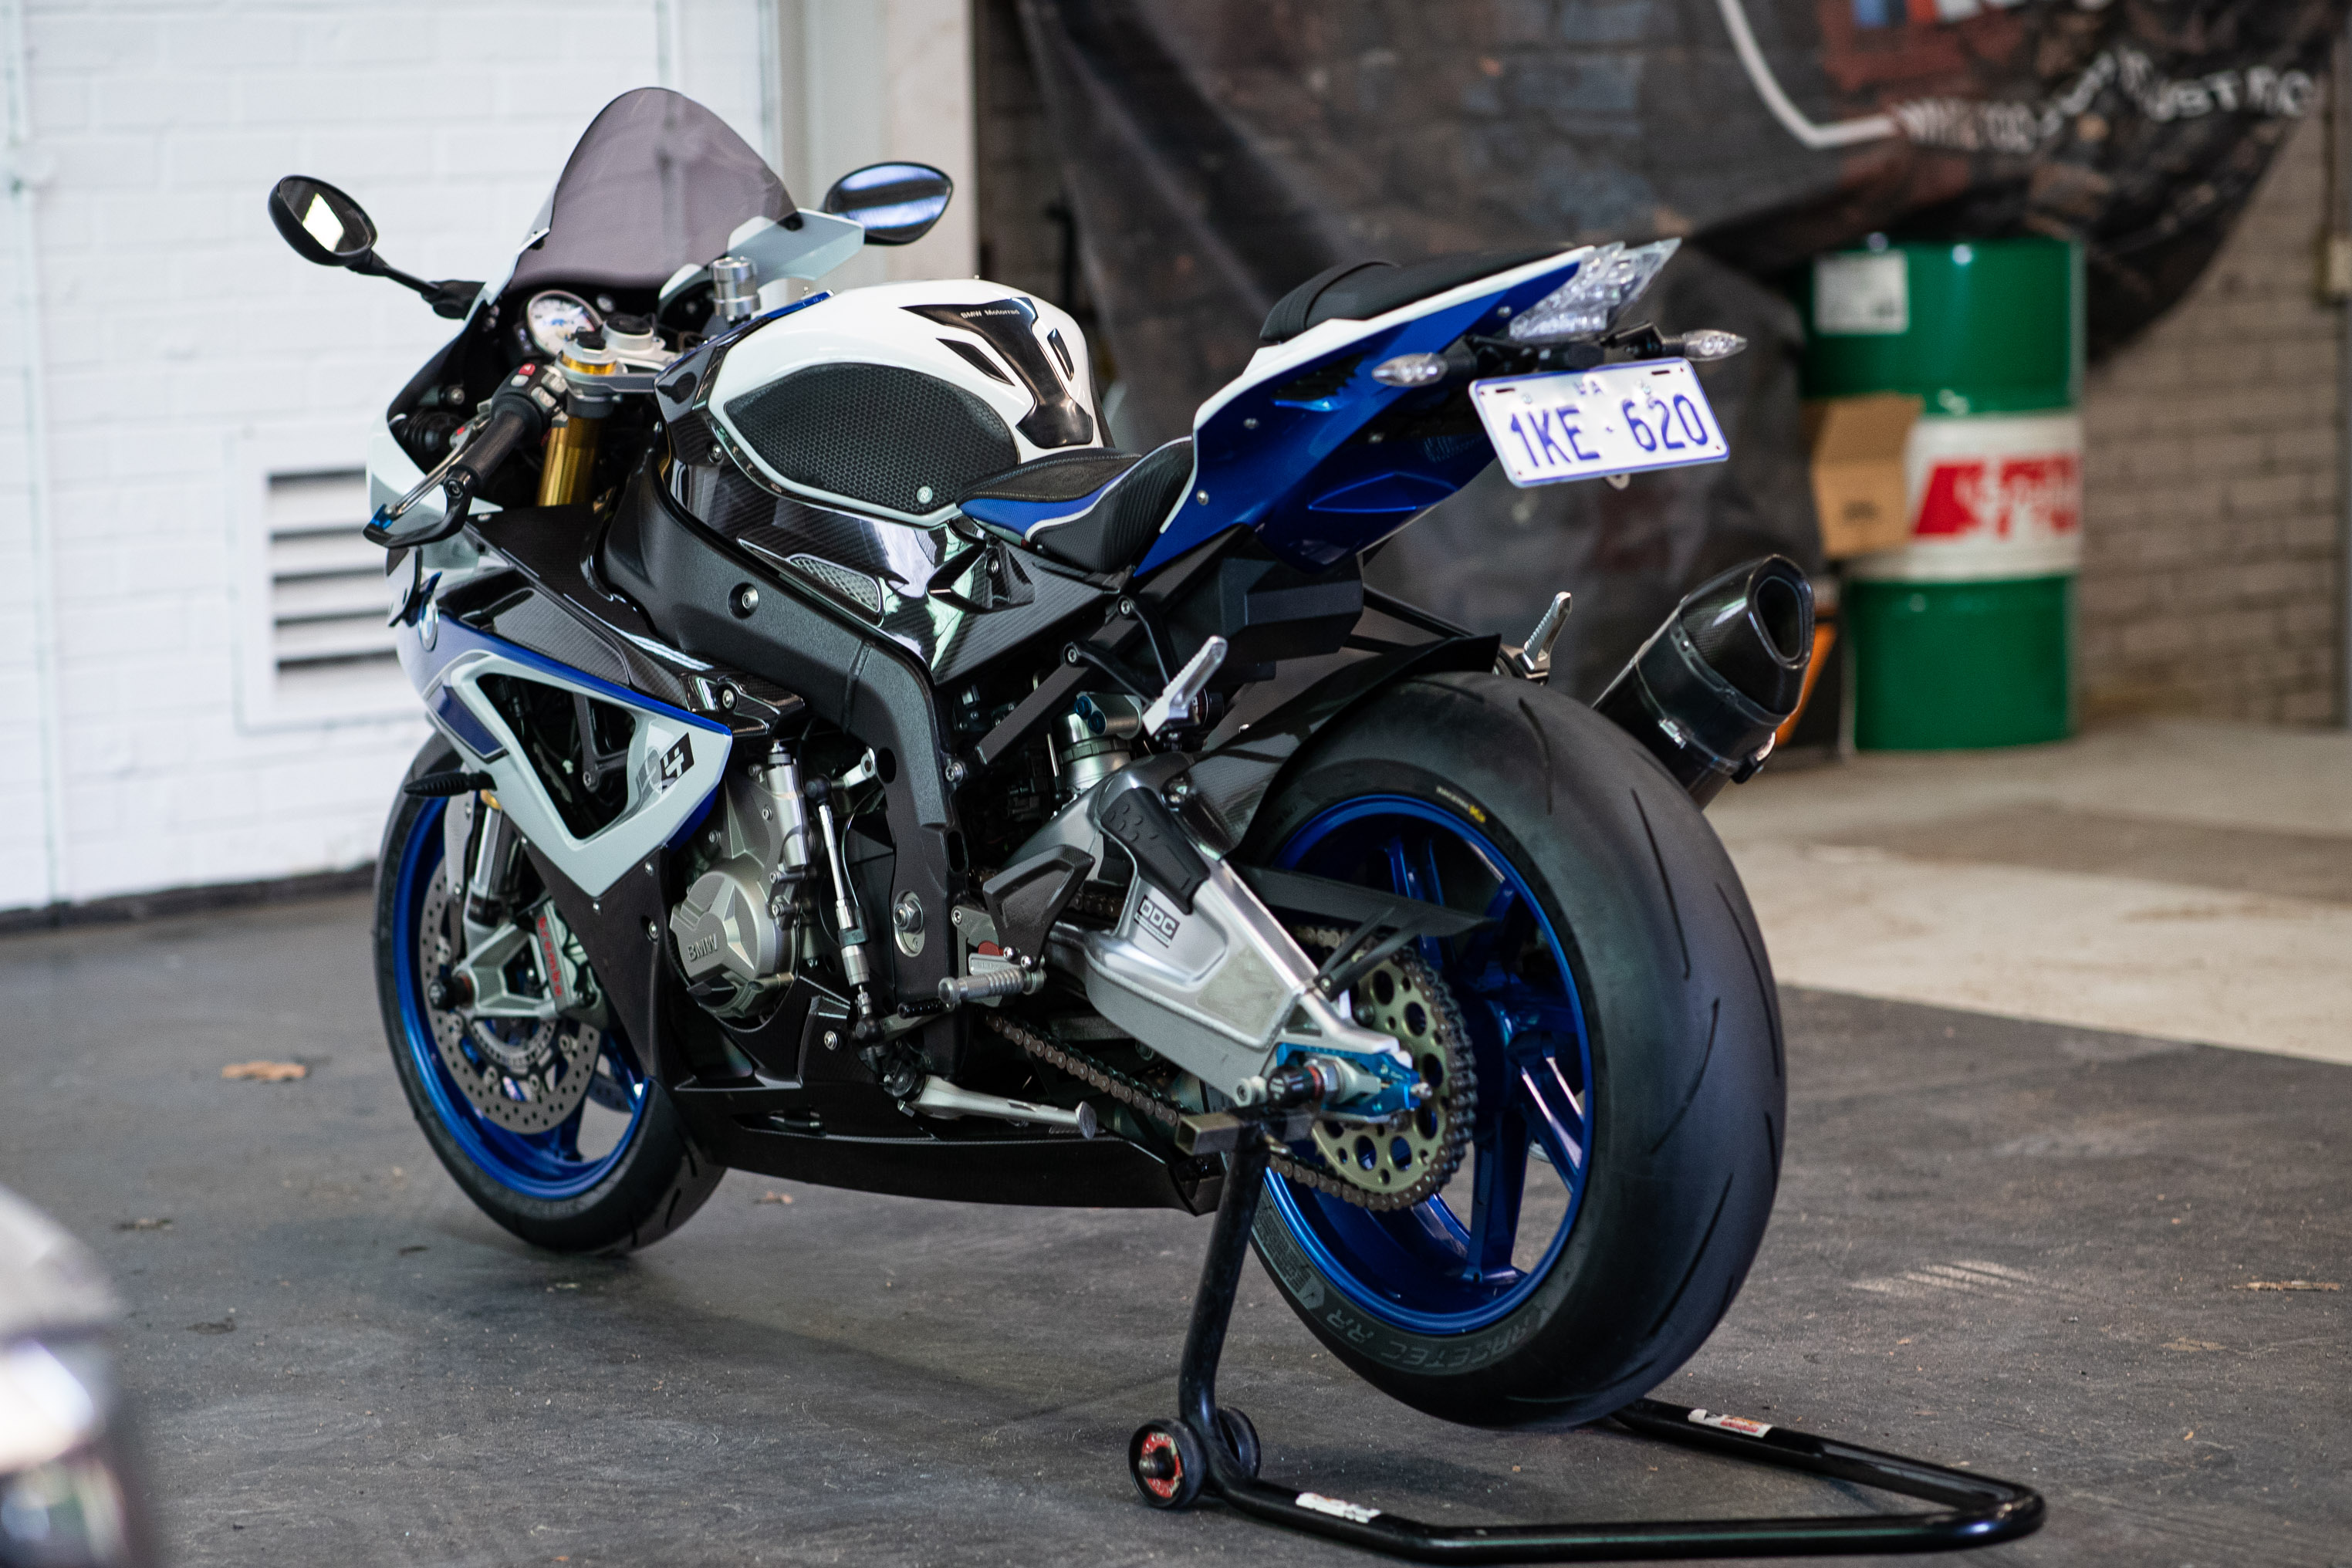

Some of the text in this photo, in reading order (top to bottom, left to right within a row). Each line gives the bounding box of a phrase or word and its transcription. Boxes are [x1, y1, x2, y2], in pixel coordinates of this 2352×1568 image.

[960, 310, 982, 319] BMW
[1510, 404, 1600, 468] 1KE
[1622, 394, 1709, 452] 620
[1140, 898, 1177, 936] DDC
[687, 934, 718, 962] BMW
